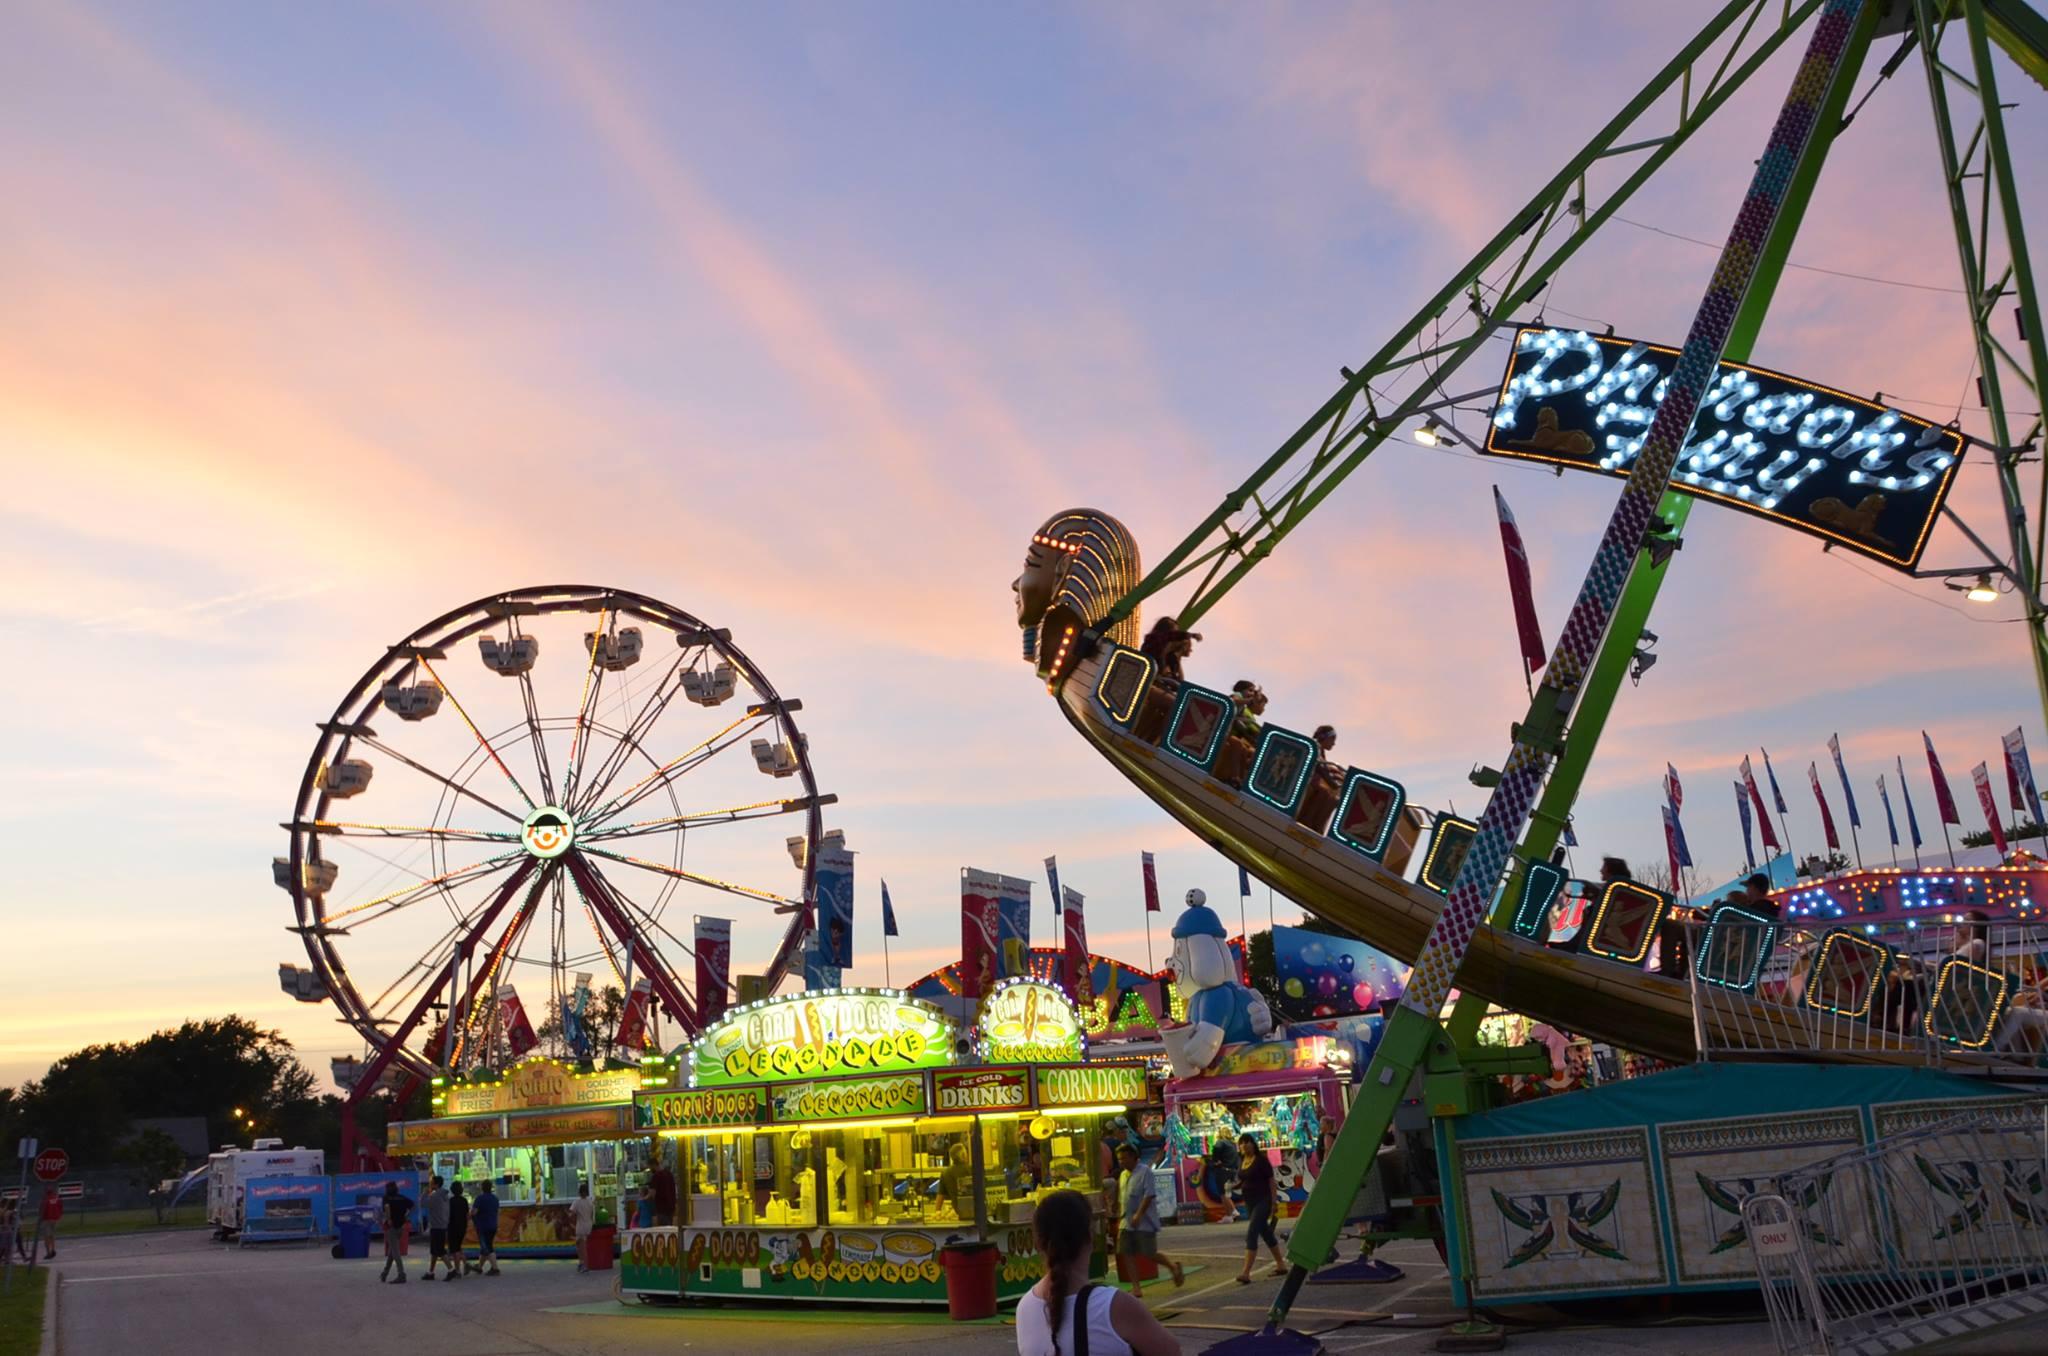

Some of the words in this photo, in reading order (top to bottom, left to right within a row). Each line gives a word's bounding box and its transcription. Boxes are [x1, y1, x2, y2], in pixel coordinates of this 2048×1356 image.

[749, 1006, 797, 1047] CORN
[838, 1000, 892, 1035] DOGS
[729, 1031, 923, 1074] LEMONADE
[994, 1044, 1072, 1059] LEMONADE
[586, 1077, 626, 1089] GOURMET
[959, 1078, 975, 1087] ICE
[976, 1074, 1003, 1083] COLD
[1047, 1069, 1092, 1102] CORN
[1096, 1068, 1138, 1101] DOGS
[457, 1090, 478, 1100] FRESH
[480, 1089, 496, 1099] CUT
[801, 1081, 917, 1113] LEMONADE
[942, 1085, 1024, 1107] DRINKS
[460, 1099, 493, 1110] FRIES
[663, 1097, 702, 1120] CORN
[716, 1093, 758, 1120] DOGS
[37, 1158, 66, 1171] STOP
[632, 1233, 678, 1260] CORN
[710, 1233, 759, 1261] DOGS
[1761, 1233, 1788, 1245] ONLY
[842, 1248, 871, 1262] LEMONADE
[795, 1260, 939, 1281] LEMONADE
